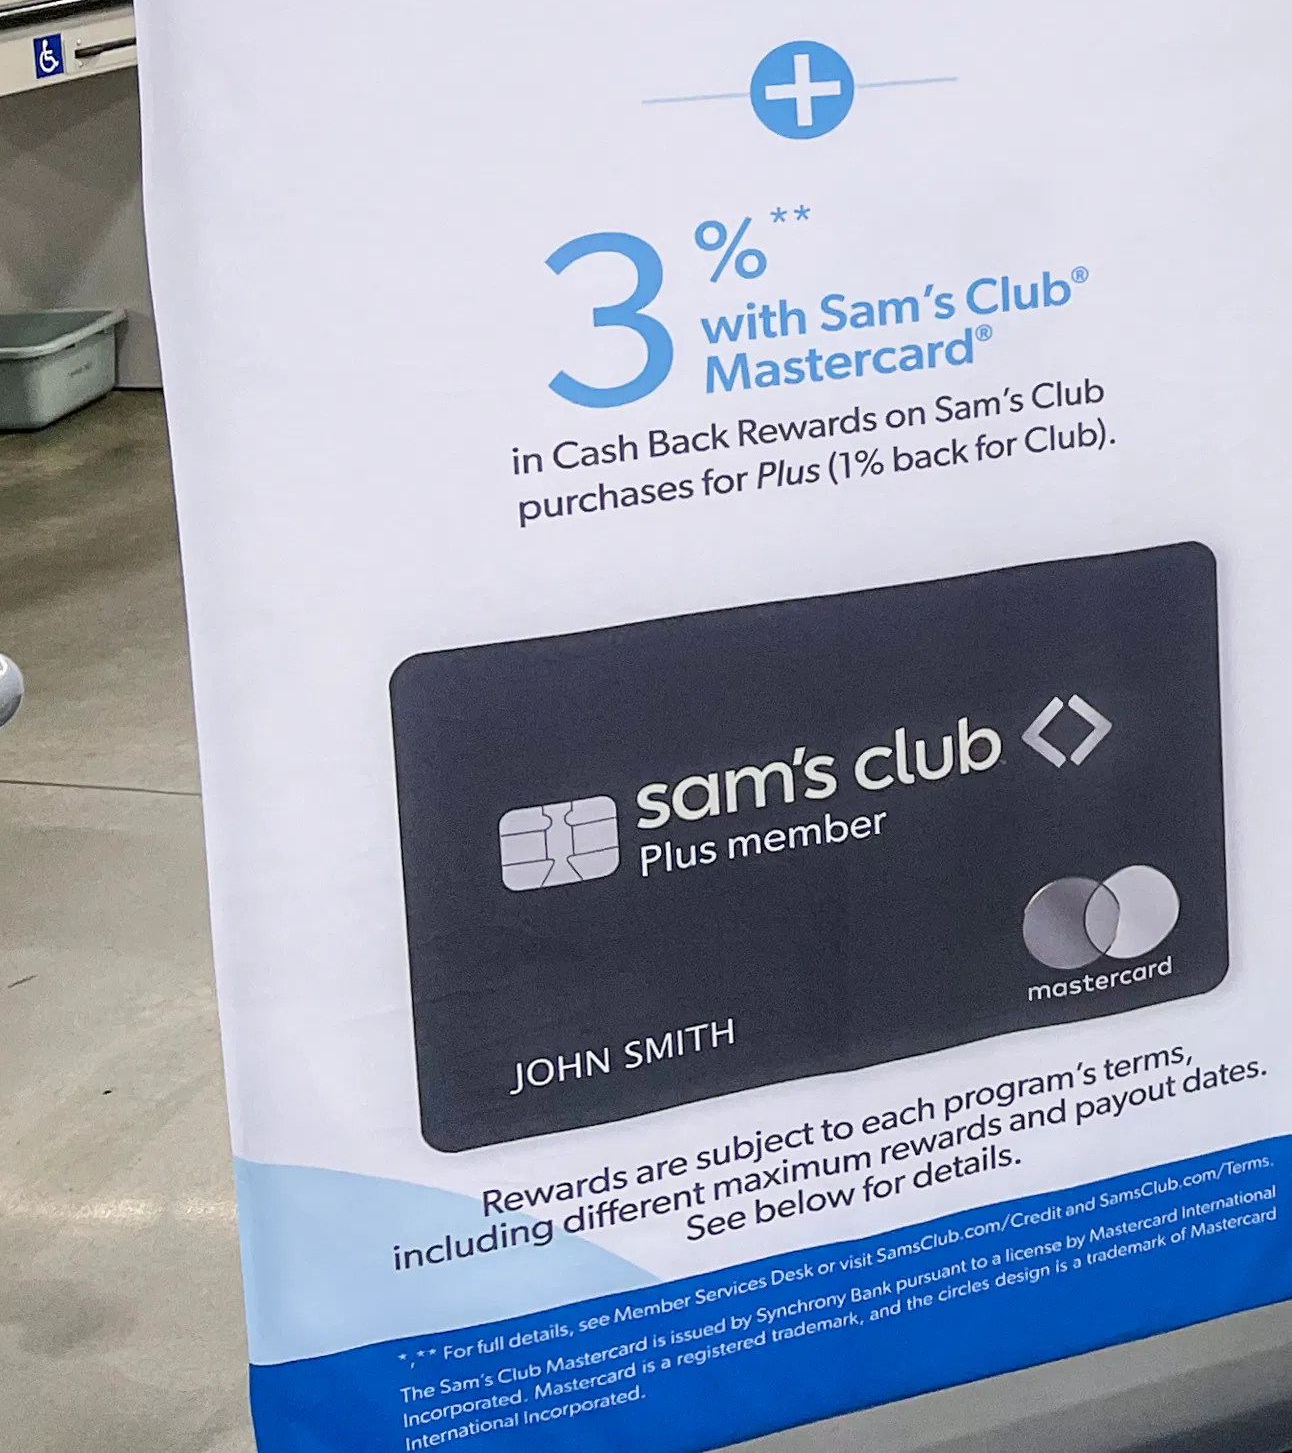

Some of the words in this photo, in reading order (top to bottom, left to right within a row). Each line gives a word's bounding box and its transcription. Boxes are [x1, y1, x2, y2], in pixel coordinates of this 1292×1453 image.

[701, 300, 806, 344] with
[513, 448, 542, 475] in
[553, 435, 638, 469] Cash
[649, 423, 729, 457] Back
[739, 407, 876, 446] Rewards
[886, 407, 925, 428] on
[1032, 378, 1104, 408] Club
[520, 480, 693, 527] purchases
[702, 469, 748, 495] for
[758, 460, 820, 489] Plus
[829, 448, 884, 485] (1%
[893, 439, 968, 471] back
[975, 434, 1017, 460] for
[1025, 418, 1115, 452] Club).
[855, 717, 1001, 789] club
[641, 841, 716, 876] Plus
[729, 812, 886, 859] member
[1029, 956, 1171, 1001] mastercard
[510, 1048, 609, 1094] JOHN
[625, 1019, 733, 1068] SMITH
[394, 1220, 552, 1270] including
[564, 1183, 705, 1233] different
[714, 1152, 870, 1200] maximum
[881, 1114, 1001, 1164] rewards
[1010, 1098, 1065, 1131] and
[1076, 1076, 1176, 1125] payout
[1183, 1061, 1266, 1092] dates.
[483, 1167, 627, 1217] Rewards
[637, 1157, 687, 1184] are
[697, 1123, 814, 1169] subject
[821, 1120, 853, 1141] to
[862, 1098, 934, 1134] each
[1104, 1047, 1192, 1080] terms,
[687, 1212, 746, 1240] See
[755, 1188, 855, 1223] below
[863, 1175, 905, 1202] for
[913, 1145, 1021, 1188] details.
[443, 1344, 474, 1360] For
[478, 1333, 505, 1353] full
[509, 1323, 573, 1347] details,
[578, 1314, 611, 1331] see
[614, 1294, 692, 1324] Member
[696, 1275, 767, 1304] Services
[772, 1264, 813, 1285] Desk
[818, 1262, 835, 1275] or
[840, 1253, 873, 1271] visit
[877, 1207, 1061, 1263] SamsClub.com/Credit
[1065, 1197, 1097, 1218] and
[1099, 1155, 1275, 1209] SamsClub.com/Terms.
